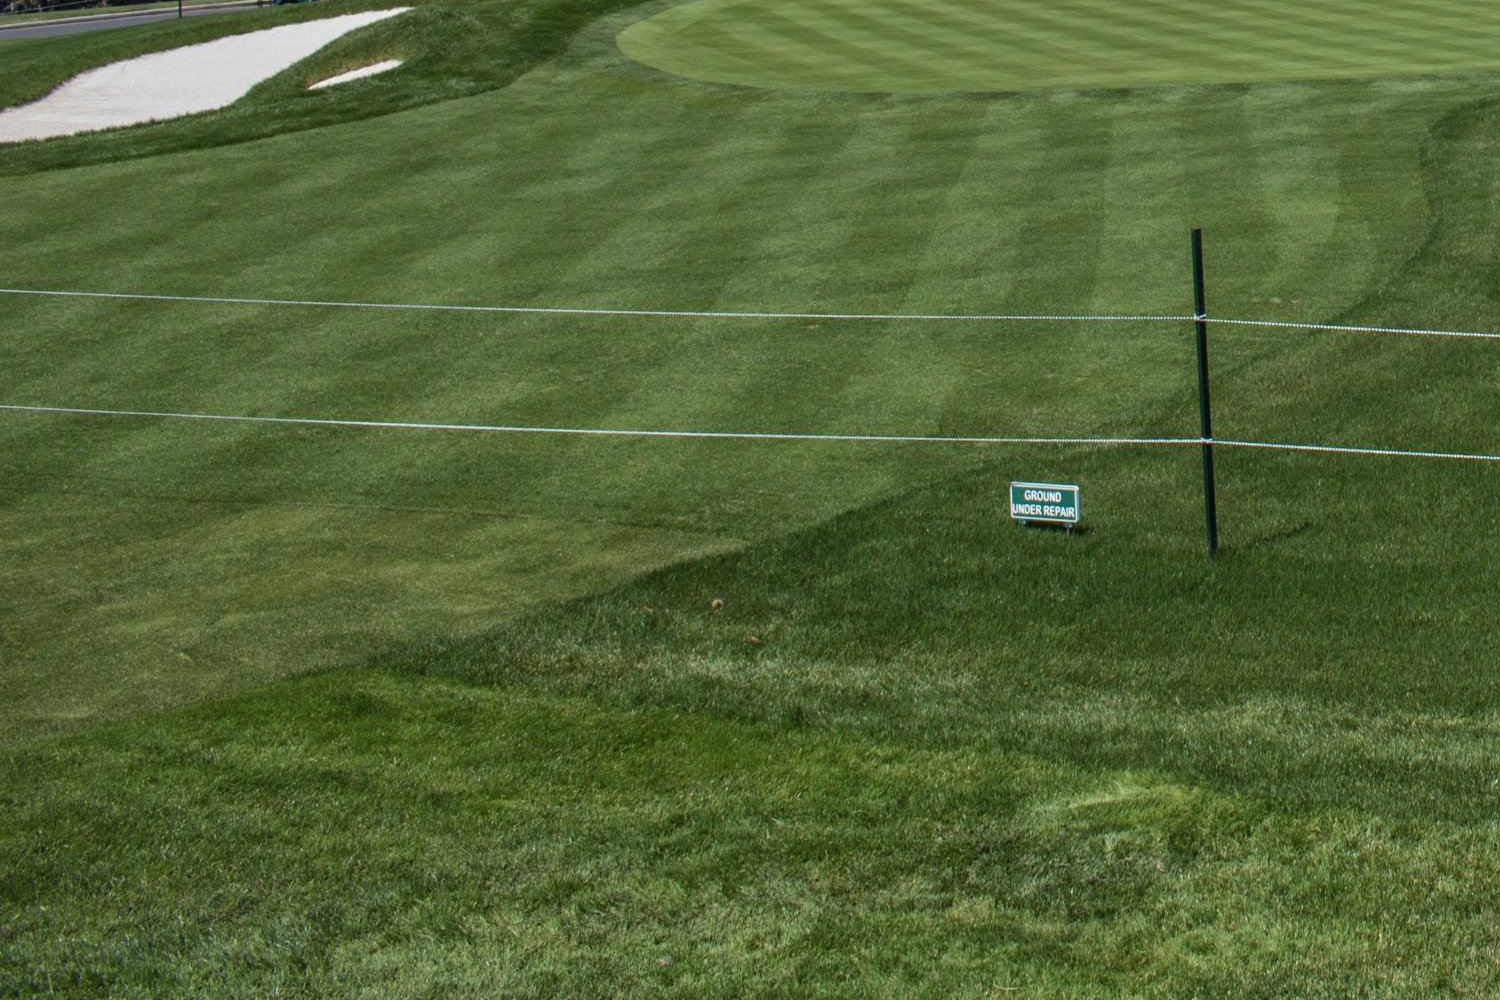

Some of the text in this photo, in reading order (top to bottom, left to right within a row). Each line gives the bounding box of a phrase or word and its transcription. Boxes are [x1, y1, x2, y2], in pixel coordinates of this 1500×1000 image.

[1024, 490, 1062, 502] GROUND
[1012, 504, 1075, 518] UNDER REPAIR
